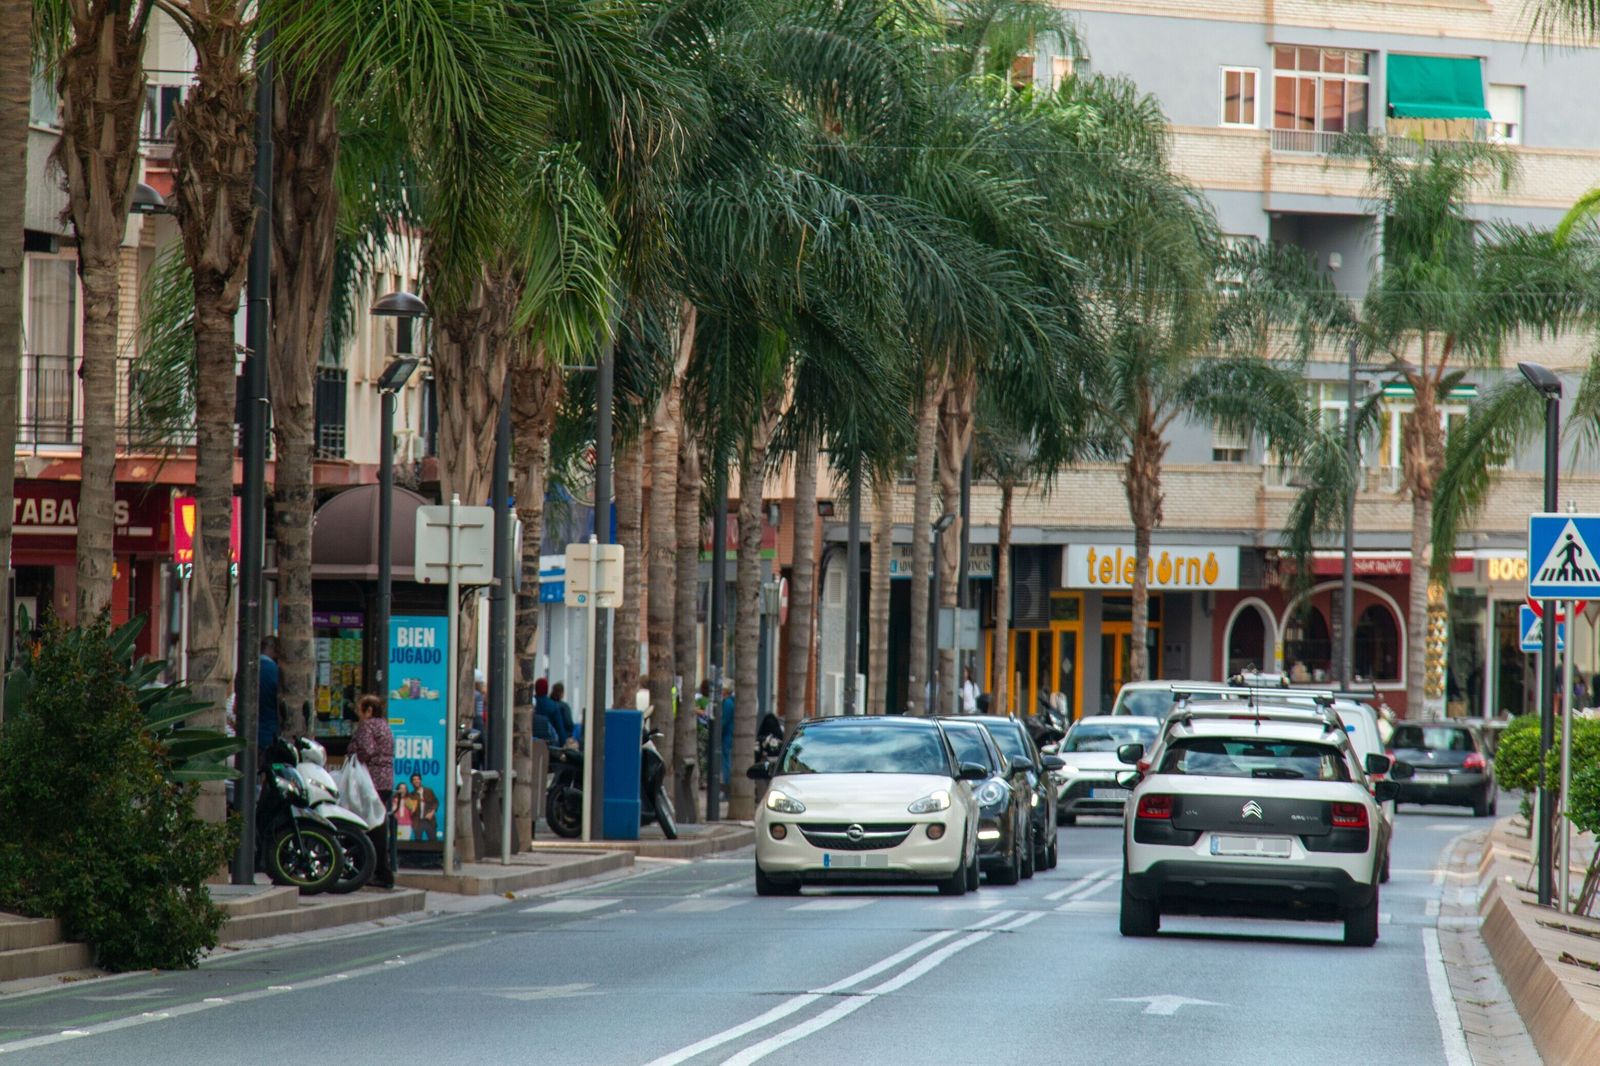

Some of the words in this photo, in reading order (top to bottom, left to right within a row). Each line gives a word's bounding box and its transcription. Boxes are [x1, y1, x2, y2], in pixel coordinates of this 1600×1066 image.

[12, 498, 129, 525] TABAS
[397, 627, 435, 648] BIEN
[390, 647, 442, 664] JUGADO
[395, 737, 433, 759] BIEN
[394, 760, 440, 776] UGADO
